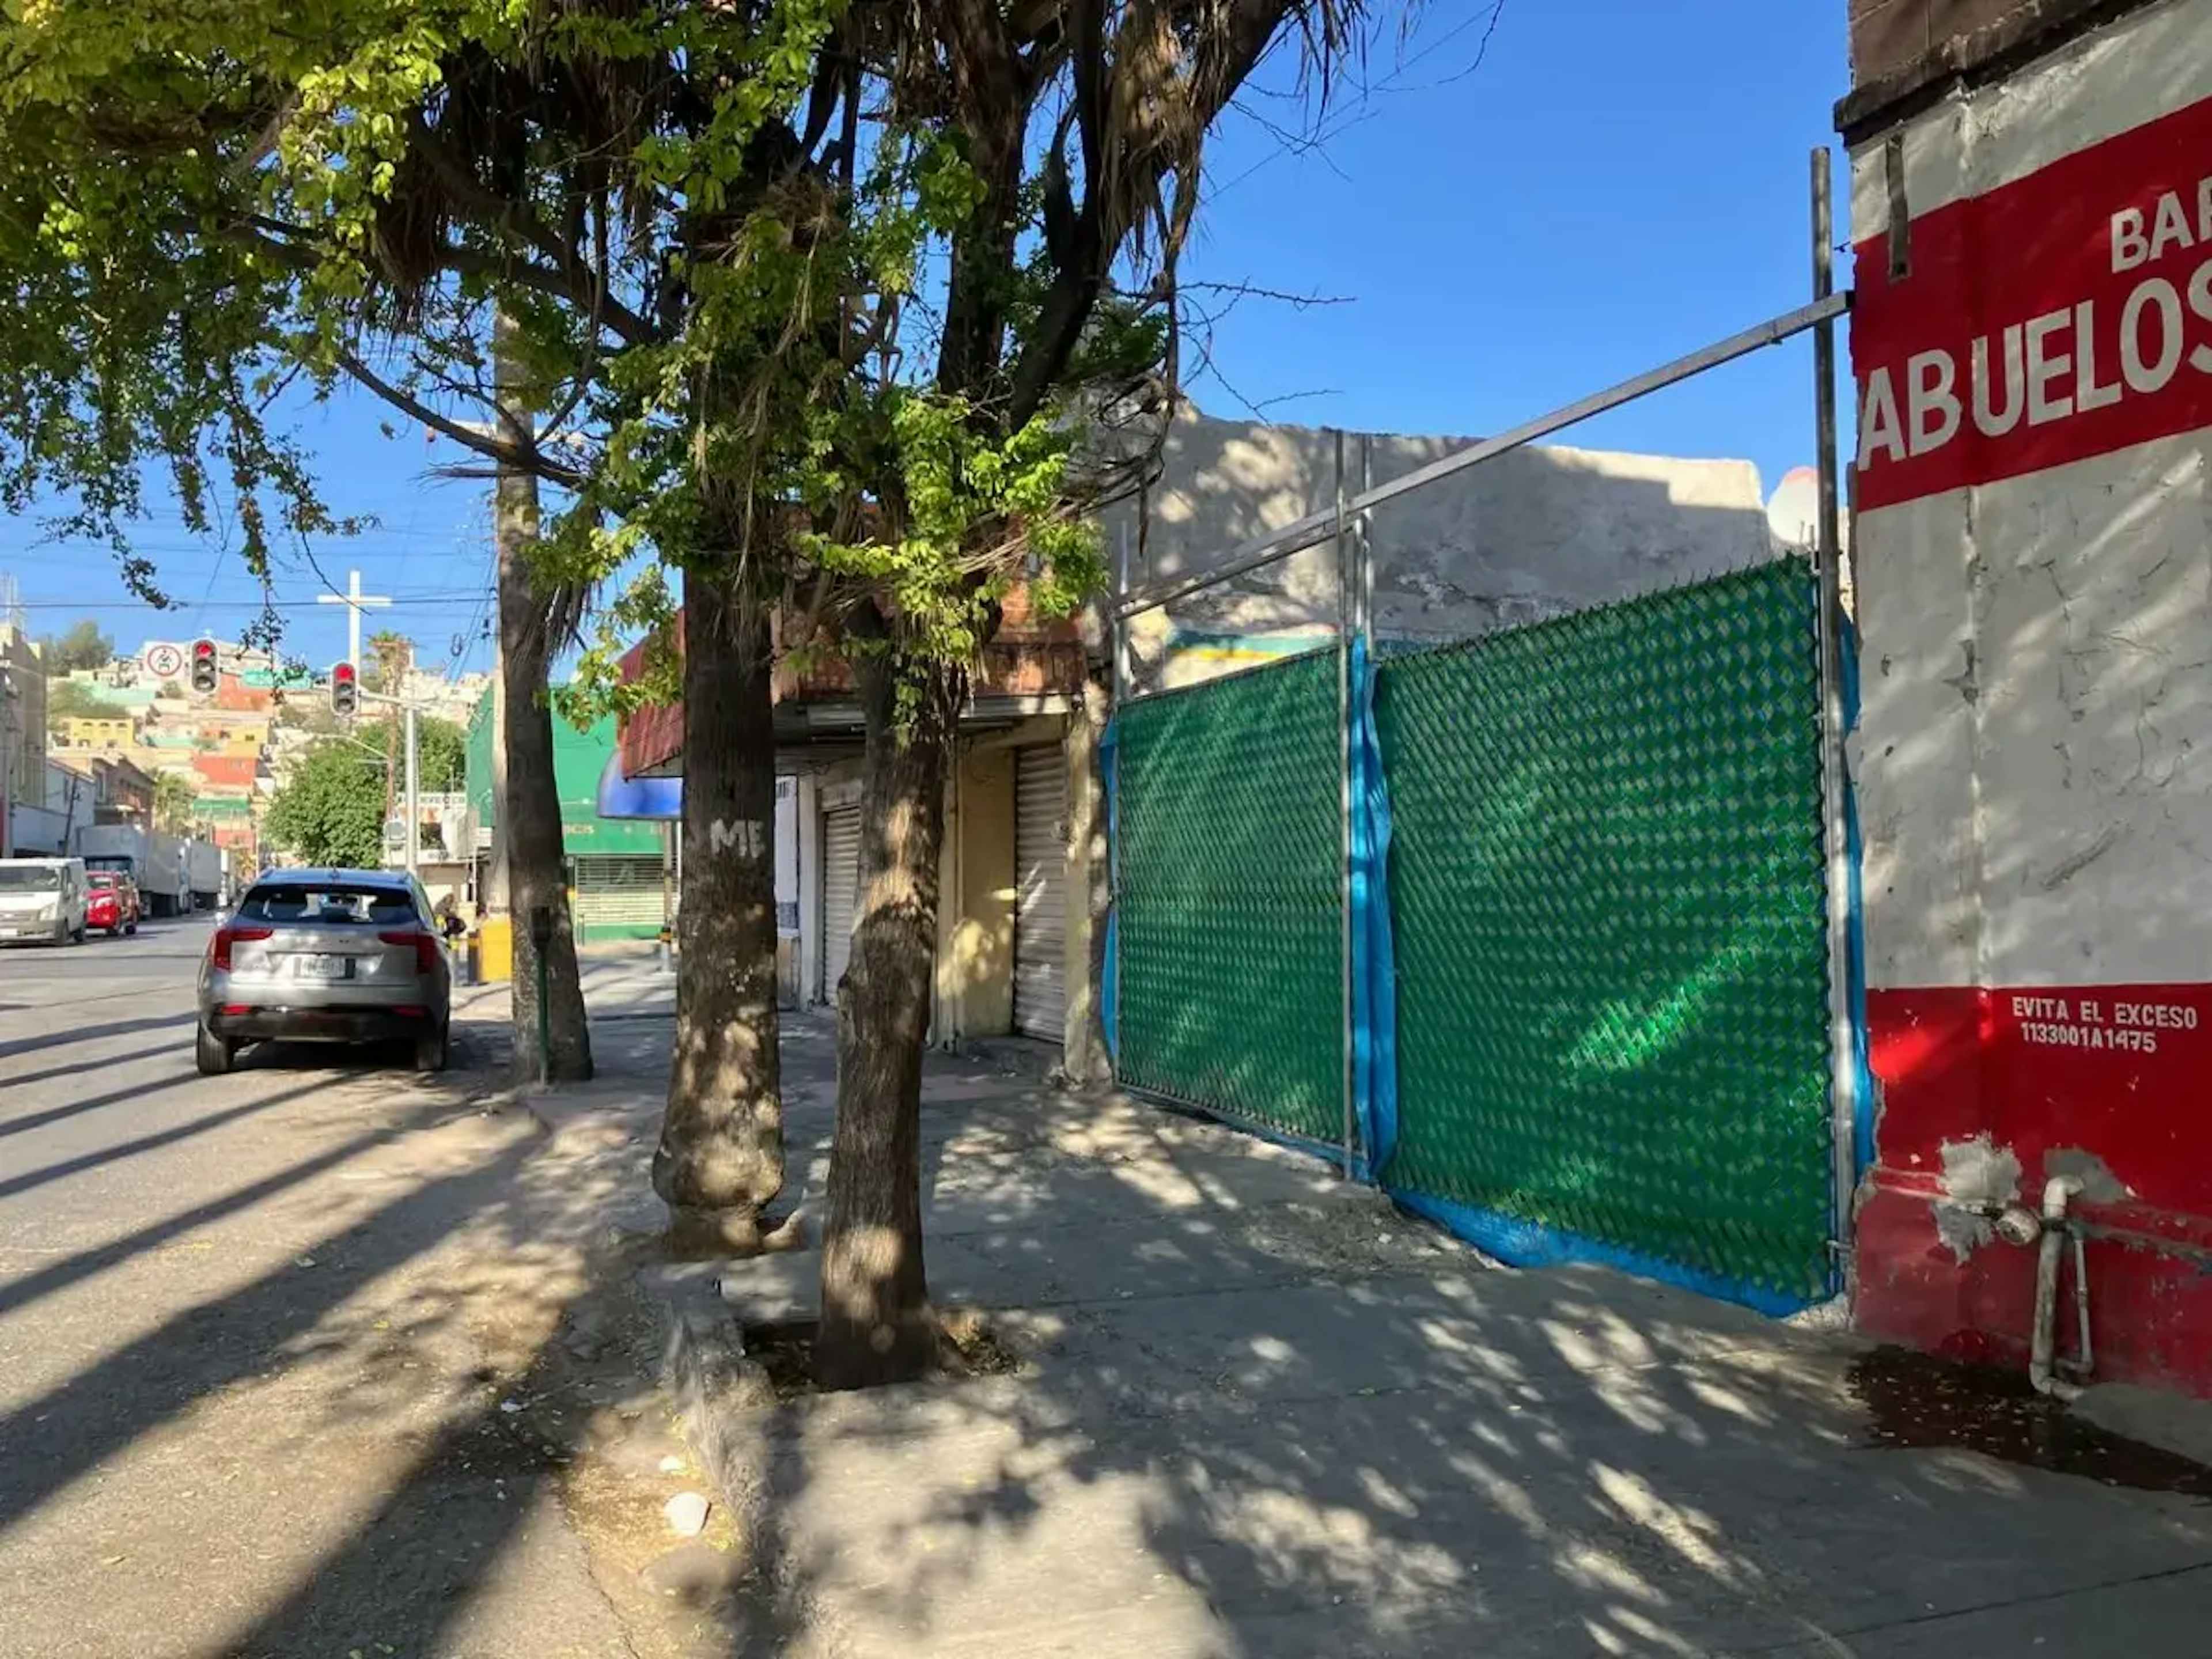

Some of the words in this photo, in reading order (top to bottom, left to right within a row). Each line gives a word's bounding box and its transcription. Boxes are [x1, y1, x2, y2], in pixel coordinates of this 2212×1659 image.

[2012, 997, 2070, 1021] EVITA
[2080, 1000, 2104, 1022] EL
[2114, 1002, 2198, 1029] EXCESO
